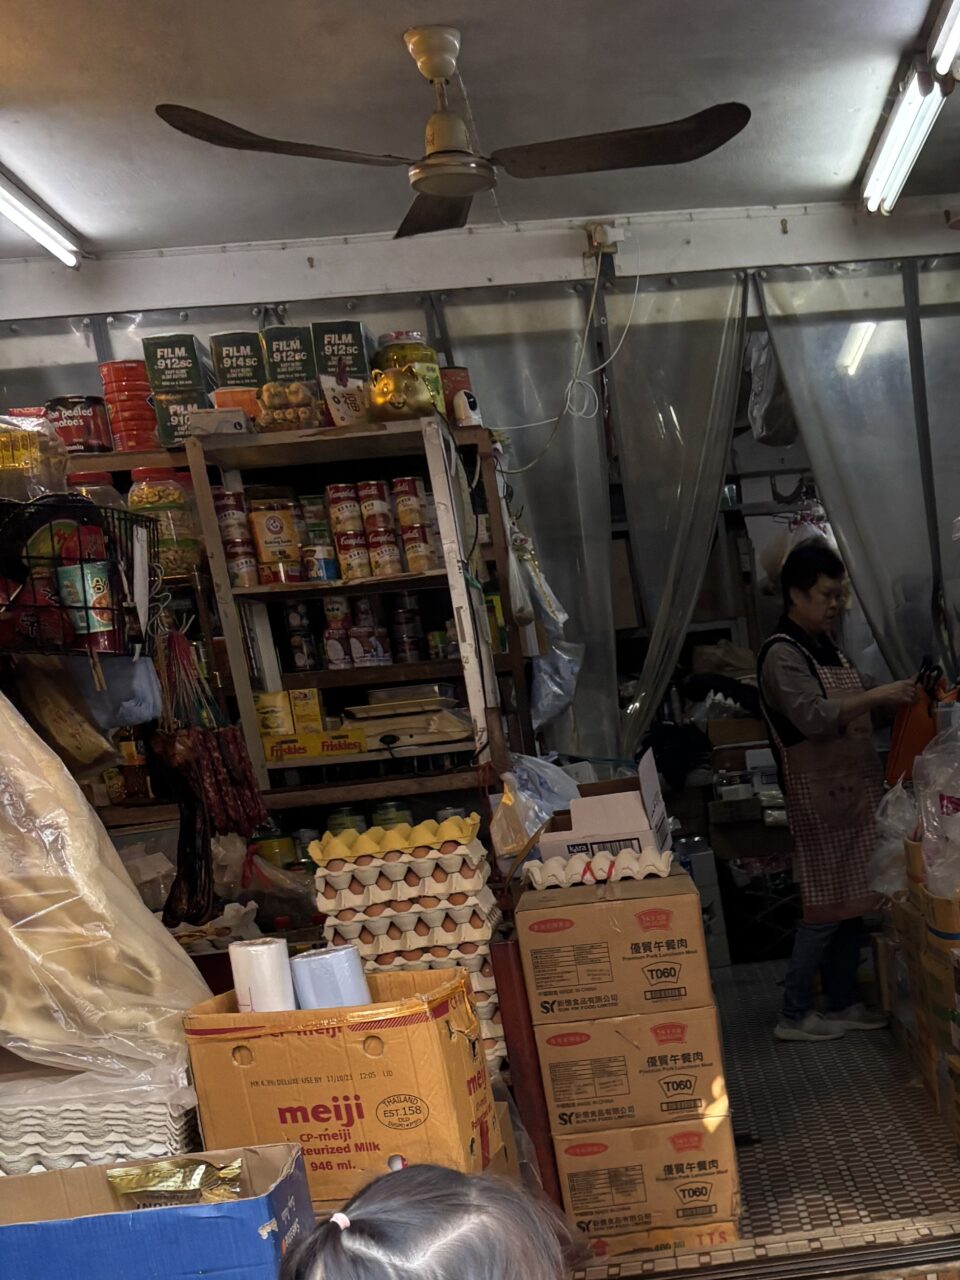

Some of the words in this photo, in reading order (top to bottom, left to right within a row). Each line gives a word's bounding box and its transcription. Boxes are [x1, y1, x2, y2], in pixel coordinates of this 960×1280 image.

[324, 333, 353, 344] FILM
[222, 345, 251, 357] FILM
[272, 339, 301, 351] FILM
[157, 347, 186, 359] FILM
[62, 408, 93, 421] peeled
[169, 403, 198, 415] FILM
[647, 966, 677, 980] T060
[663, 1079, 692, 1092] T060
[382, 1096, 419, 1107] THAILAND
[278, 1094, 364, 1128] meiji
[299, 1128, 351, 1143] CP-meiji
[354, 1141, 381, 1153] Milk
[310, 1160, 333, 1171] 946
[680, 1186, 708, 1199] T060
